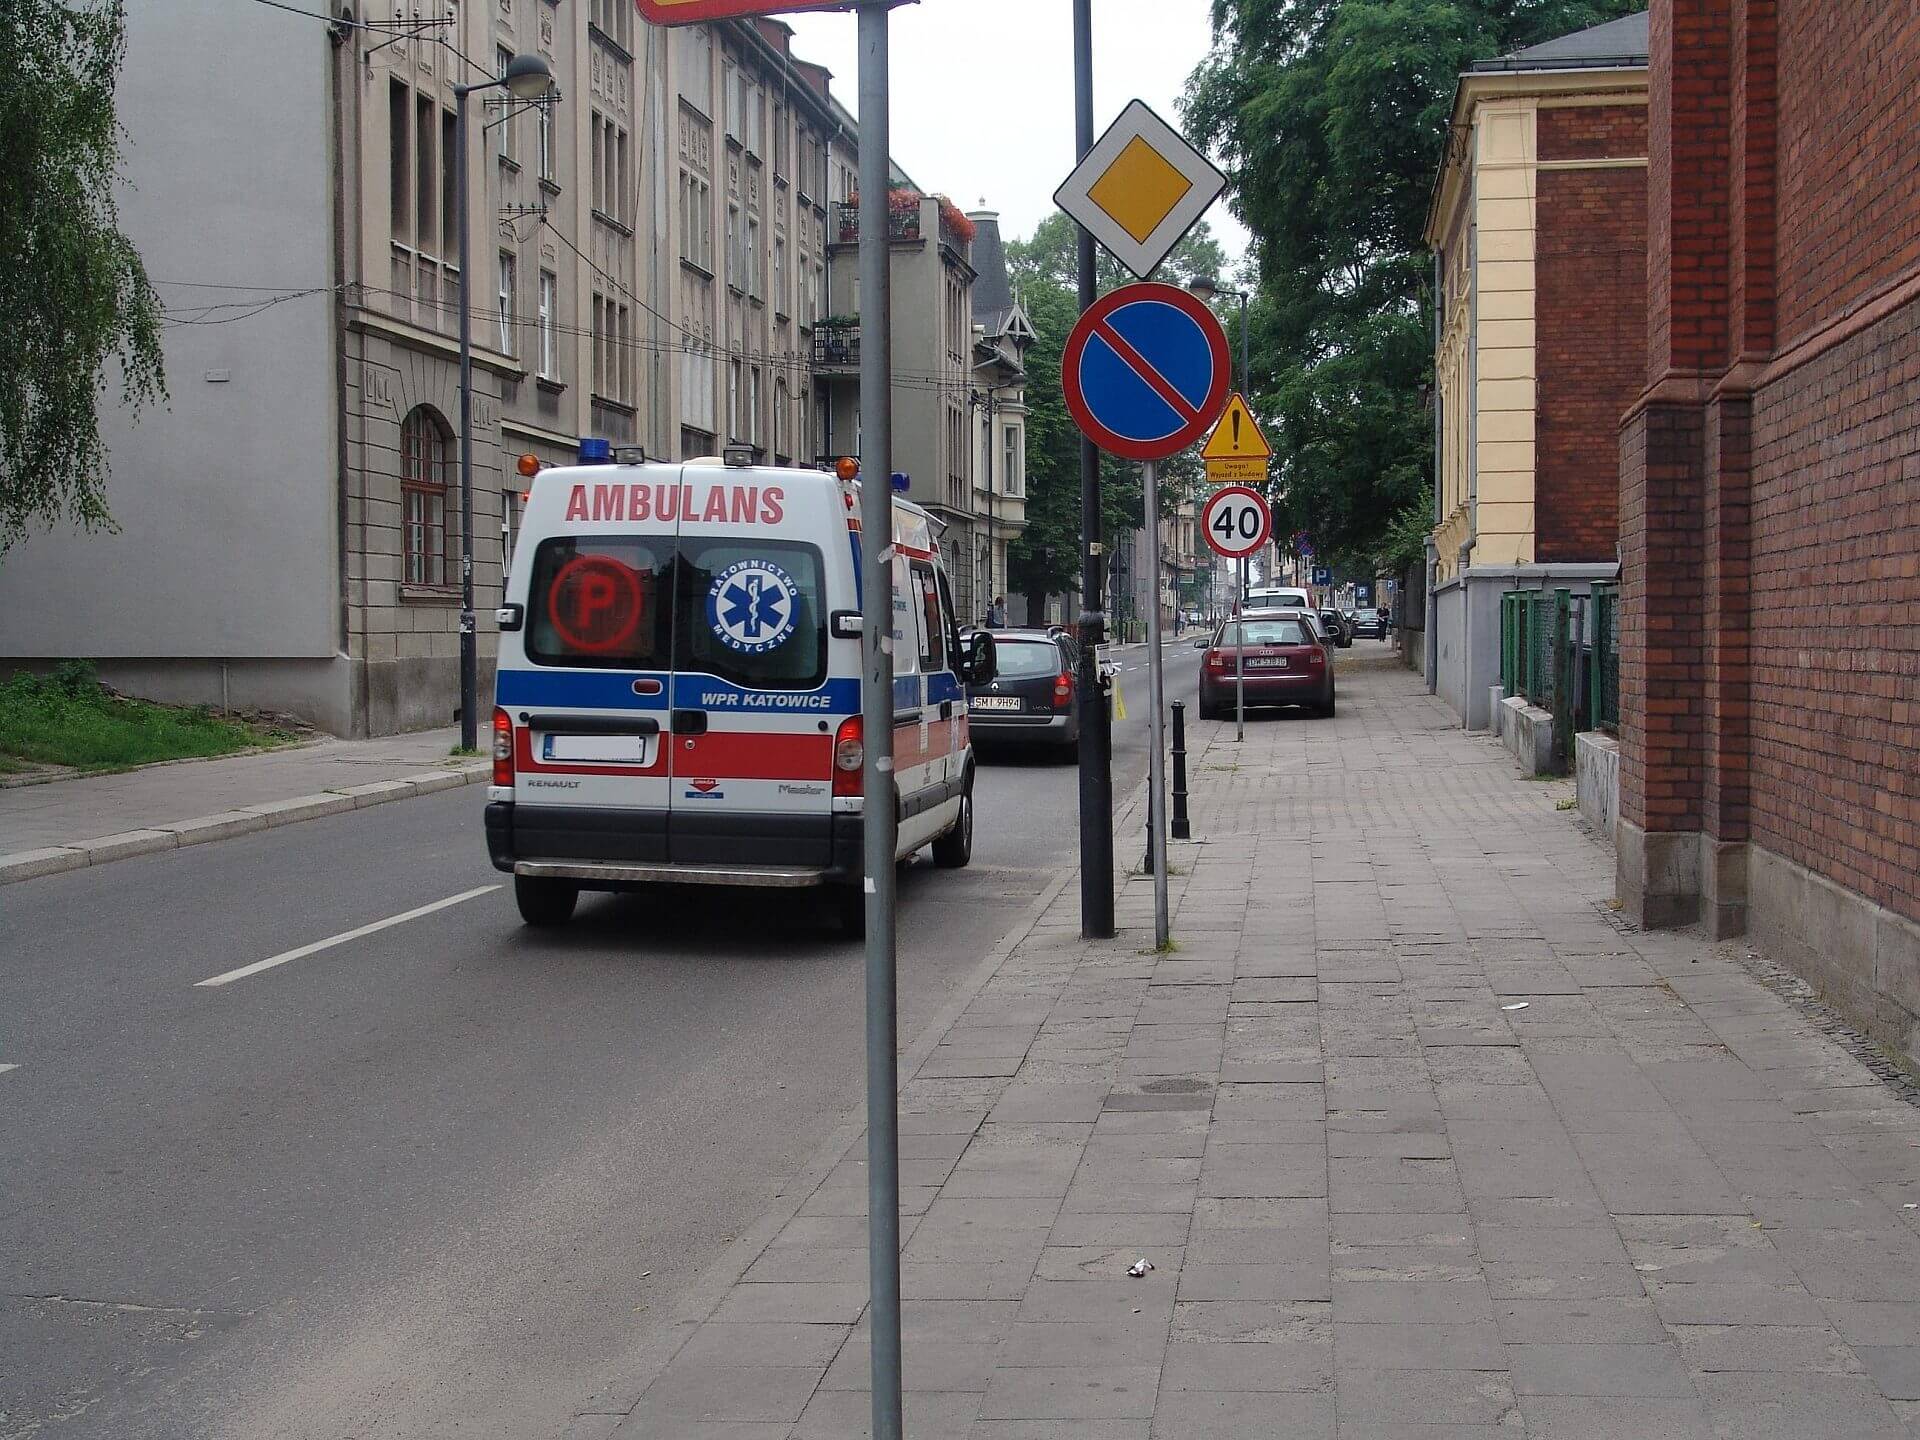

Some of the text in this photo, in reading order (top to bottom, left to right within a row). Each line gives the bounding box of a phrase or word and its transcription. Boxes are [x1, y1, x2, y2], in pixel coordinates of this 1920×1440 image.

[565, 484, 785, 525] AMBULANS
[1213, 506, 1260, 539] 40
[709, 560, 798, 596] RATOWNICTWO
[713, 623, 794, 652] MEDYCZNE
[701, 693, 832, 708] WPR KATOWICE
[997, 698, 1019, 708] 9H94
[527, 779, 581, 789] RENAULT
[778, 784, 826, 795] Master
